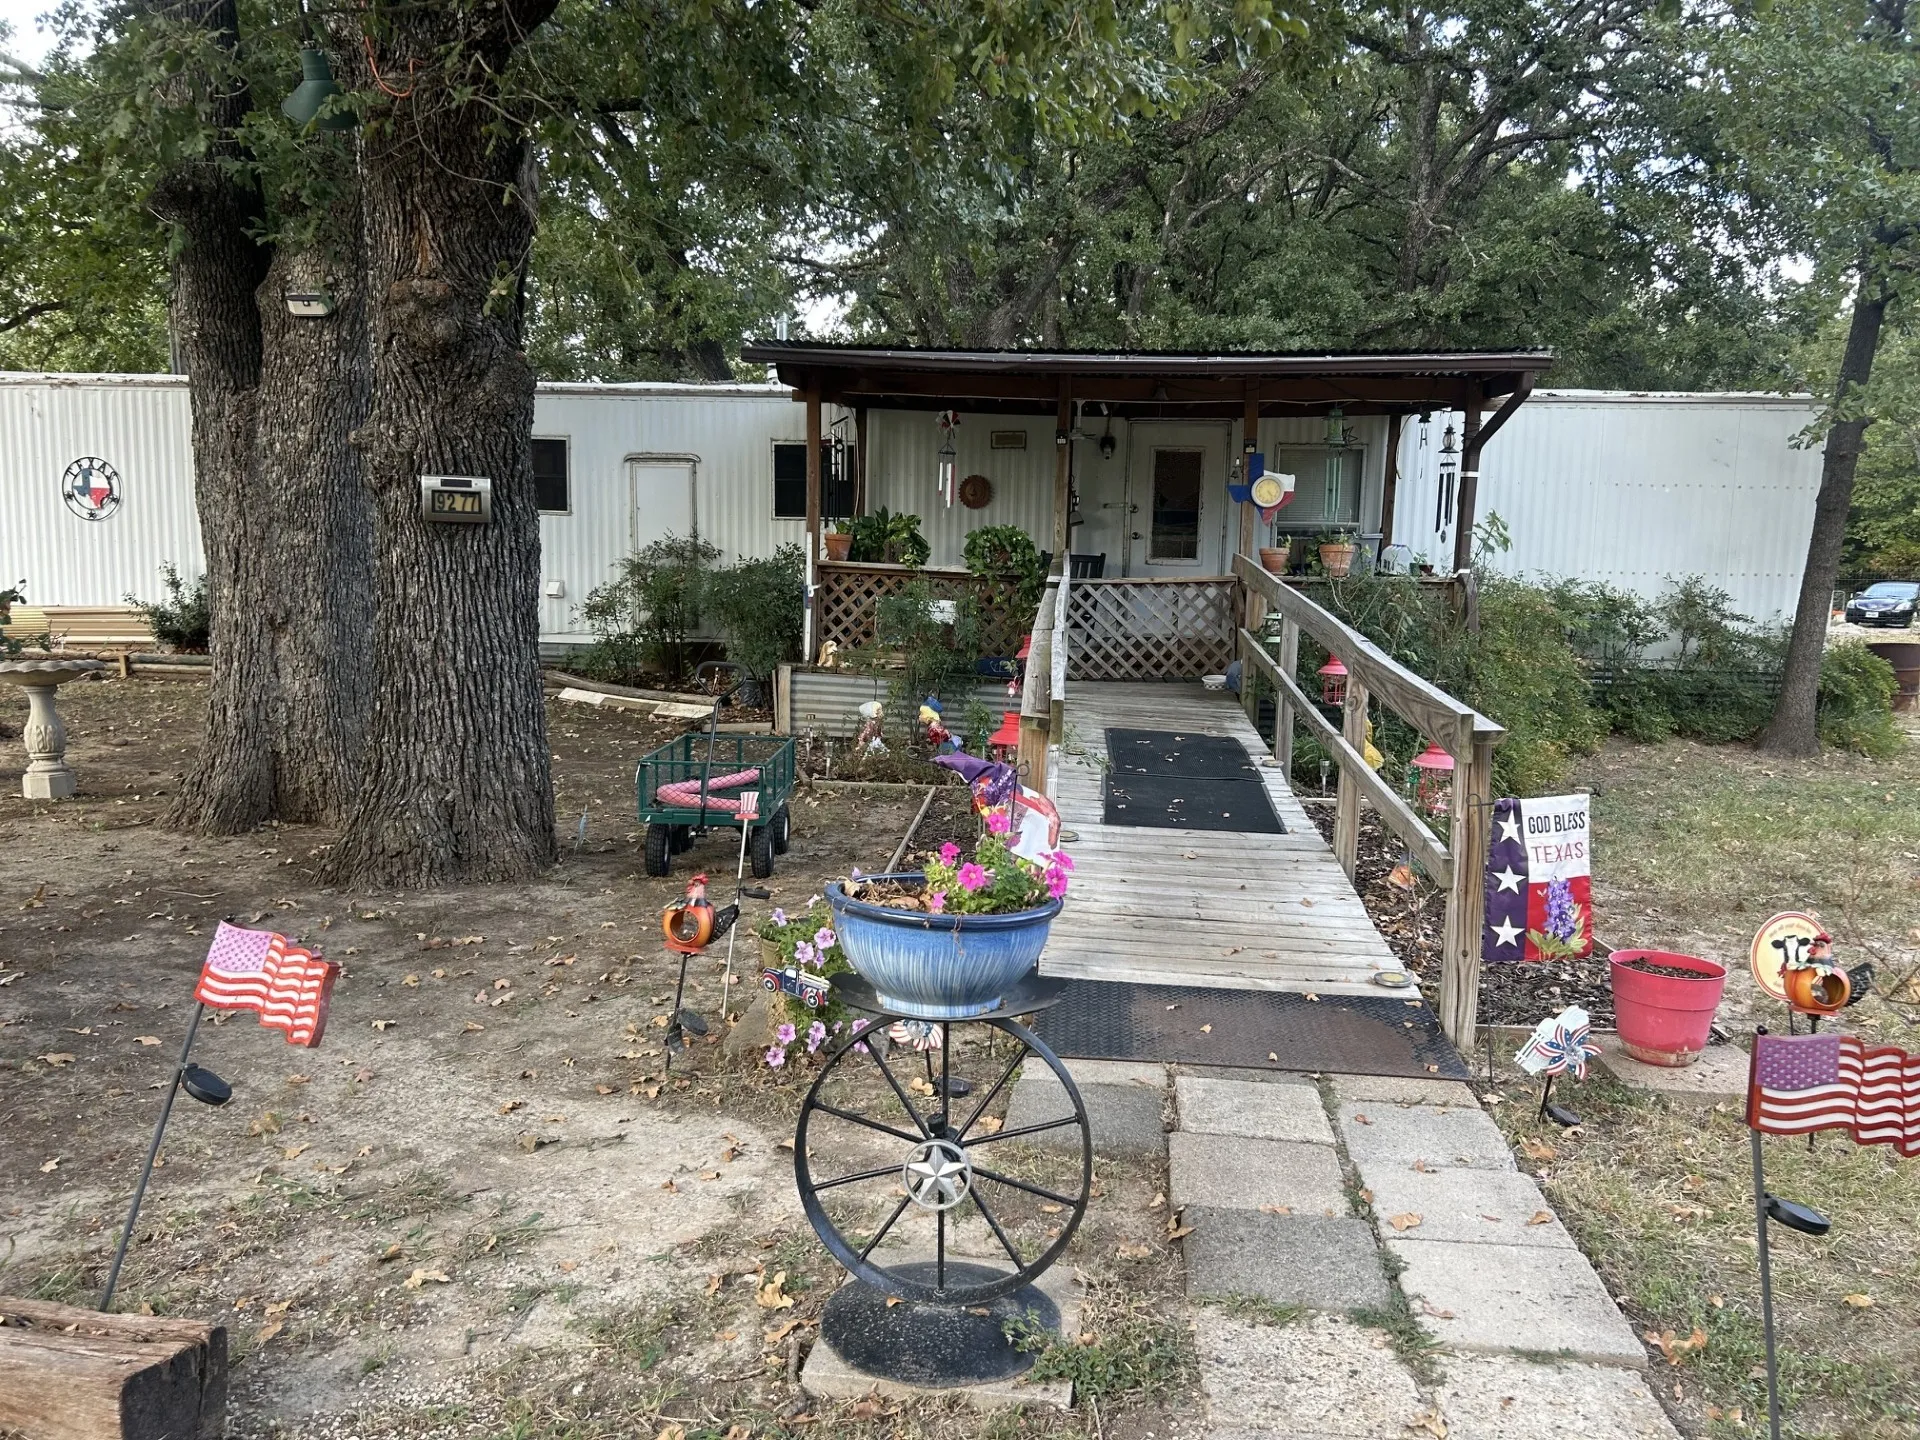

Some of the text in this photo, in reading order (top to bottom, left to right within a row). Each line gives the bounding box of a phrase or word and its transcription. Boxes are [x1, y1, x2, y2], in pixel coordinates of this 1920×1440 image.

[65, 457, 117, 480] TEXAS
[437, 493, 477, 512] 9277
[1528, 811, 1586, 834] GOD BLESS
[1531, 841, 1584, 864] TEXAS
